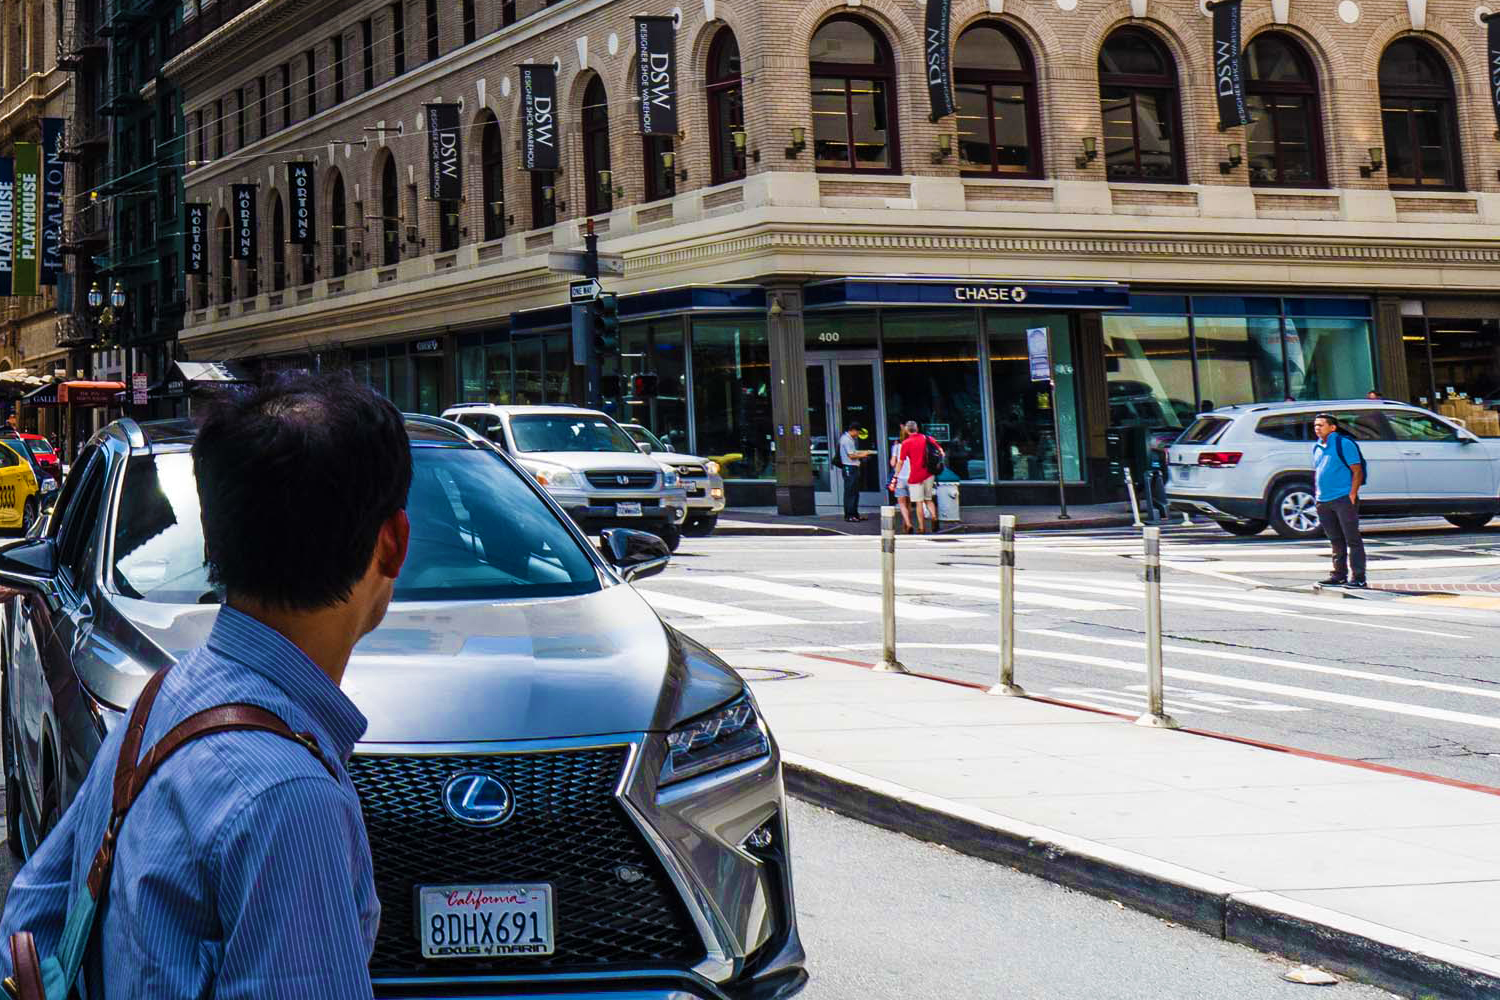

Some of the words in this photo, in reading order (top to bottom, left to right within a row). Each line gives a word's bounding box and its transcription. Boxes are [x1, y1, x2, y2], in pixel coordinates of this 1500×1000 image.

[640, 23, 648, 63] DESIGNER
[928, 27, 941, 85] DSW
[641, 64, 649, 86] SHOE
[650, 52, 671, 110] DSW
[1216, 40, 1234, 96] DSW
[524, 70, 533, 105] DESIGNER
[430, 109, 439, 141] DESIGNER
[526, 106, 534, 126] SHOE
[534, 96, 553, 147] DSW
[642, 88, 652, 133] WAREHOUS
[432, 142, 440, 160] SHOE
[440, 133, 457, 178] DSW
[527, 128, 535, 169] WAREHOUS
[22, 173, 37, 260] PLAYHOUSE
[572, 287, 582, 295] ONE
[583, 286, 592, 294] WAY
[954, 287, 1010, 300] CHASE
[818, 332, 840, 342] 400
[448, 888, 526, 910] California
[431, 911, 543, 946] 8DHX691
[429, 946, 481, 955] LEXUS
[496, 944, 547, 954] MARIN
